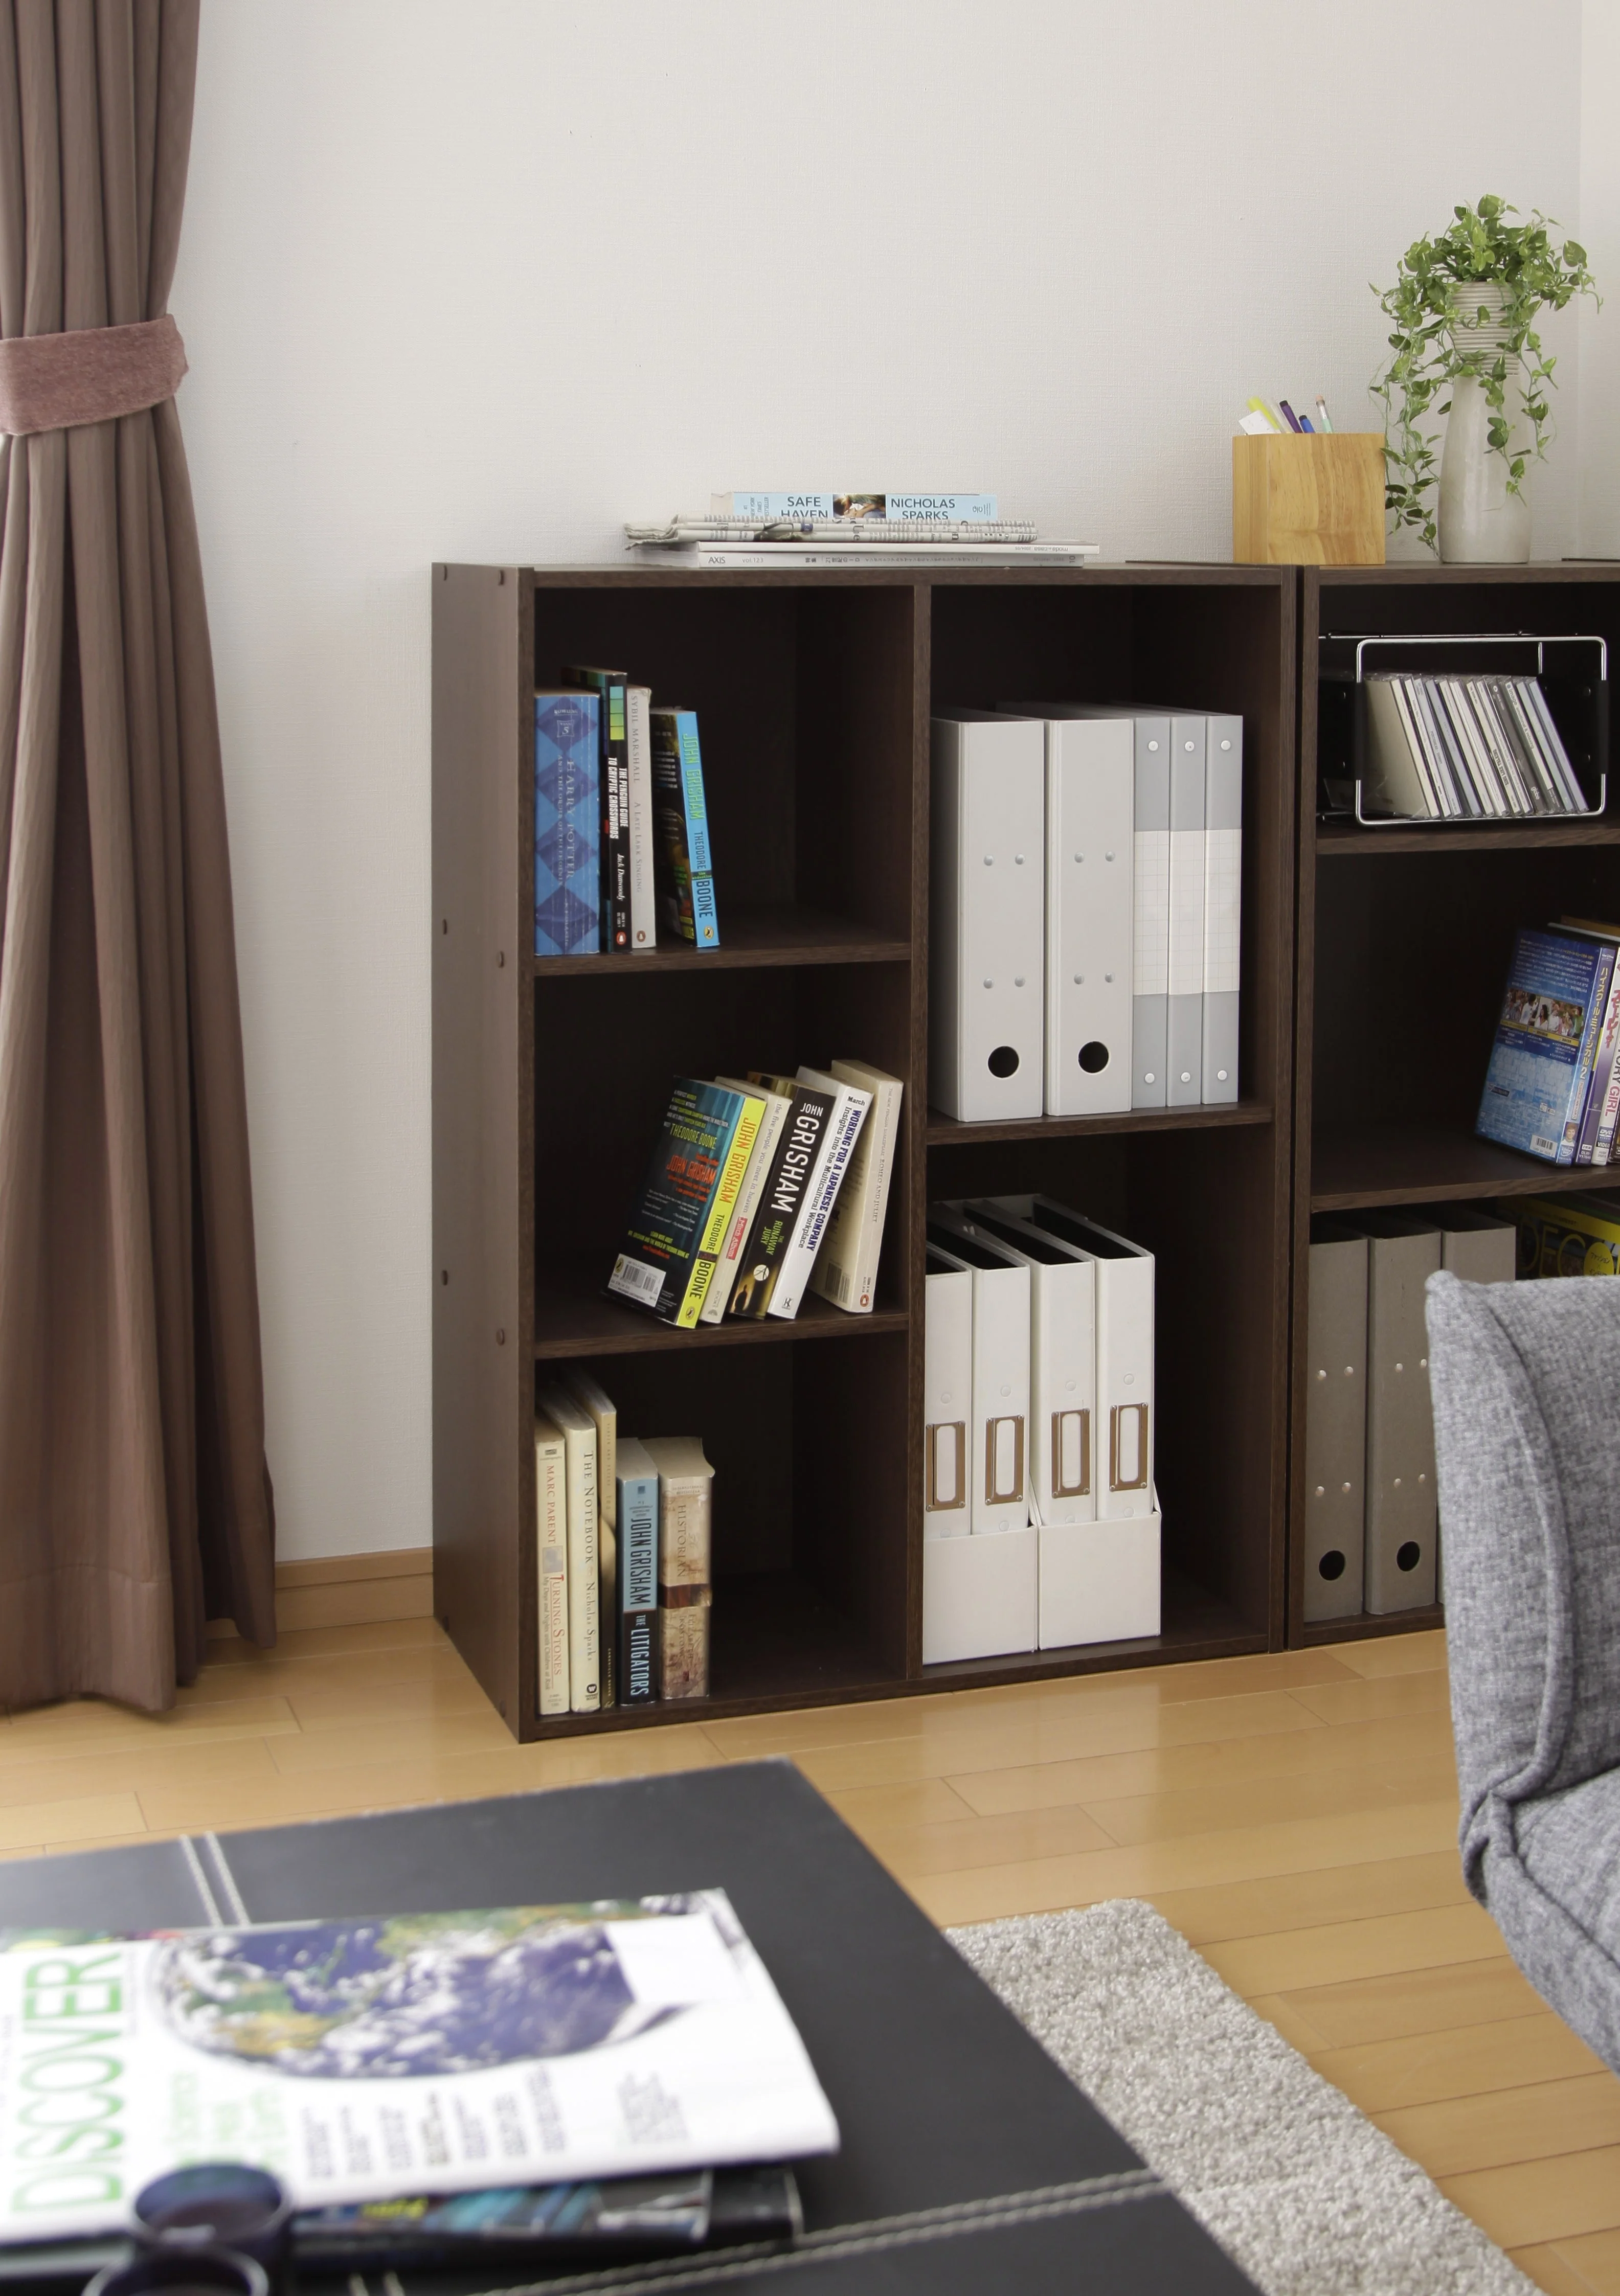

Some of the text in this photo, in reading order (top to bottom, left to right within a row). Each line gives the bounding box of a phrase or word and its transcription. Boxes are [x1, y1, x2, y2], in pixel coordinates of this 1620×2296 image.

[781, 510, 828, 518] HAVEN
[788, 496, 821, 507] SAFE
[891, 498, 955, 508] NICHOLAS
[902, 511, 949, 519] SPARKS
[1509, 688, 1517, 706] image
[1516, 707, 1526, 728] emotional
[1526, 732, 1534, 748] relaxing
[632, 729, 640, 782] MARSHALL
[683, 733, 704, 820] JOHN GRISHAM
[1531, 786, 1540, 800] globe
[609, 758, 619, 839] TO CRYPTIC CROSSWORDS
[619, 768, 628, 827] THE PENGUIN GUIDE
[558, 821, 562, 830] OF
[566, 760, 575, 878] HARRY POTTER
[694, 831, 706, 870] THEODORE
[617, 869, 625, 901] Dunwoody
[696, 879, 713, 918] BOONE
[800, 1102, 823, 1117] JOHN
[847, 1096, 865, 1106] March
[1605, 1085, 1620, 1117] GIRL
[670, 1123, 700, 1143] THEODORE
[770, 1115, 779, 1128] five
[837, 1106, 852, 1134] Insights
[841, 1108, 862, 1146] WORKING
[762, 1129, 773, 1150] people
[836, 1149, 848, 1163] FOR
[666, 1155, 688, 1174] JOHN
[687, 1162, 717, 1186] GRISHAM
[719, 1117, 757, 1204] JOHN GRISHAM
[753, 1165, 762, 1183] meet
[758, 1151, 767, 1165] you
[771, 1116, 820, 1213] GRISHAM
[827, 1152, 836, 1164] the
[743, 1191, 755, 1213] heaven
[811, 1165, 831, 1211] Multicultural
[820, 1171, 840, 1212] JAPANESE
[706, 1214, 725, 1252] THEODORE
[735, 1219, 746, 1236] Mitch
[761, 1226, 771, 1246] JURY
[766, 1220, 783, 1255] RUNAWAY
[798, 1212, 816, 1248] Workplace
[806, 1213, 825, 1252] COMPANY
[690, 1261, 711, 1300] BOONE
[547, 1465, 556, 1543] MARC PARENT
[583, 1450, 596, 1661] THE NOTEBOOK Nicholas Sparks
[677, 1505, 687, 1577] HISTORIAN
[630, 1518, 651, 1605] JOHN GRISHAM
[543, 1576, 549, 1585] My
[550, 1575, 565, 1675] TURNING STONES
[636, 1615, 646, 1626] THE
[631, 1628, 649, 1696] LITIGATORS
[11, 1953, 124, 2214] DISCOVER
